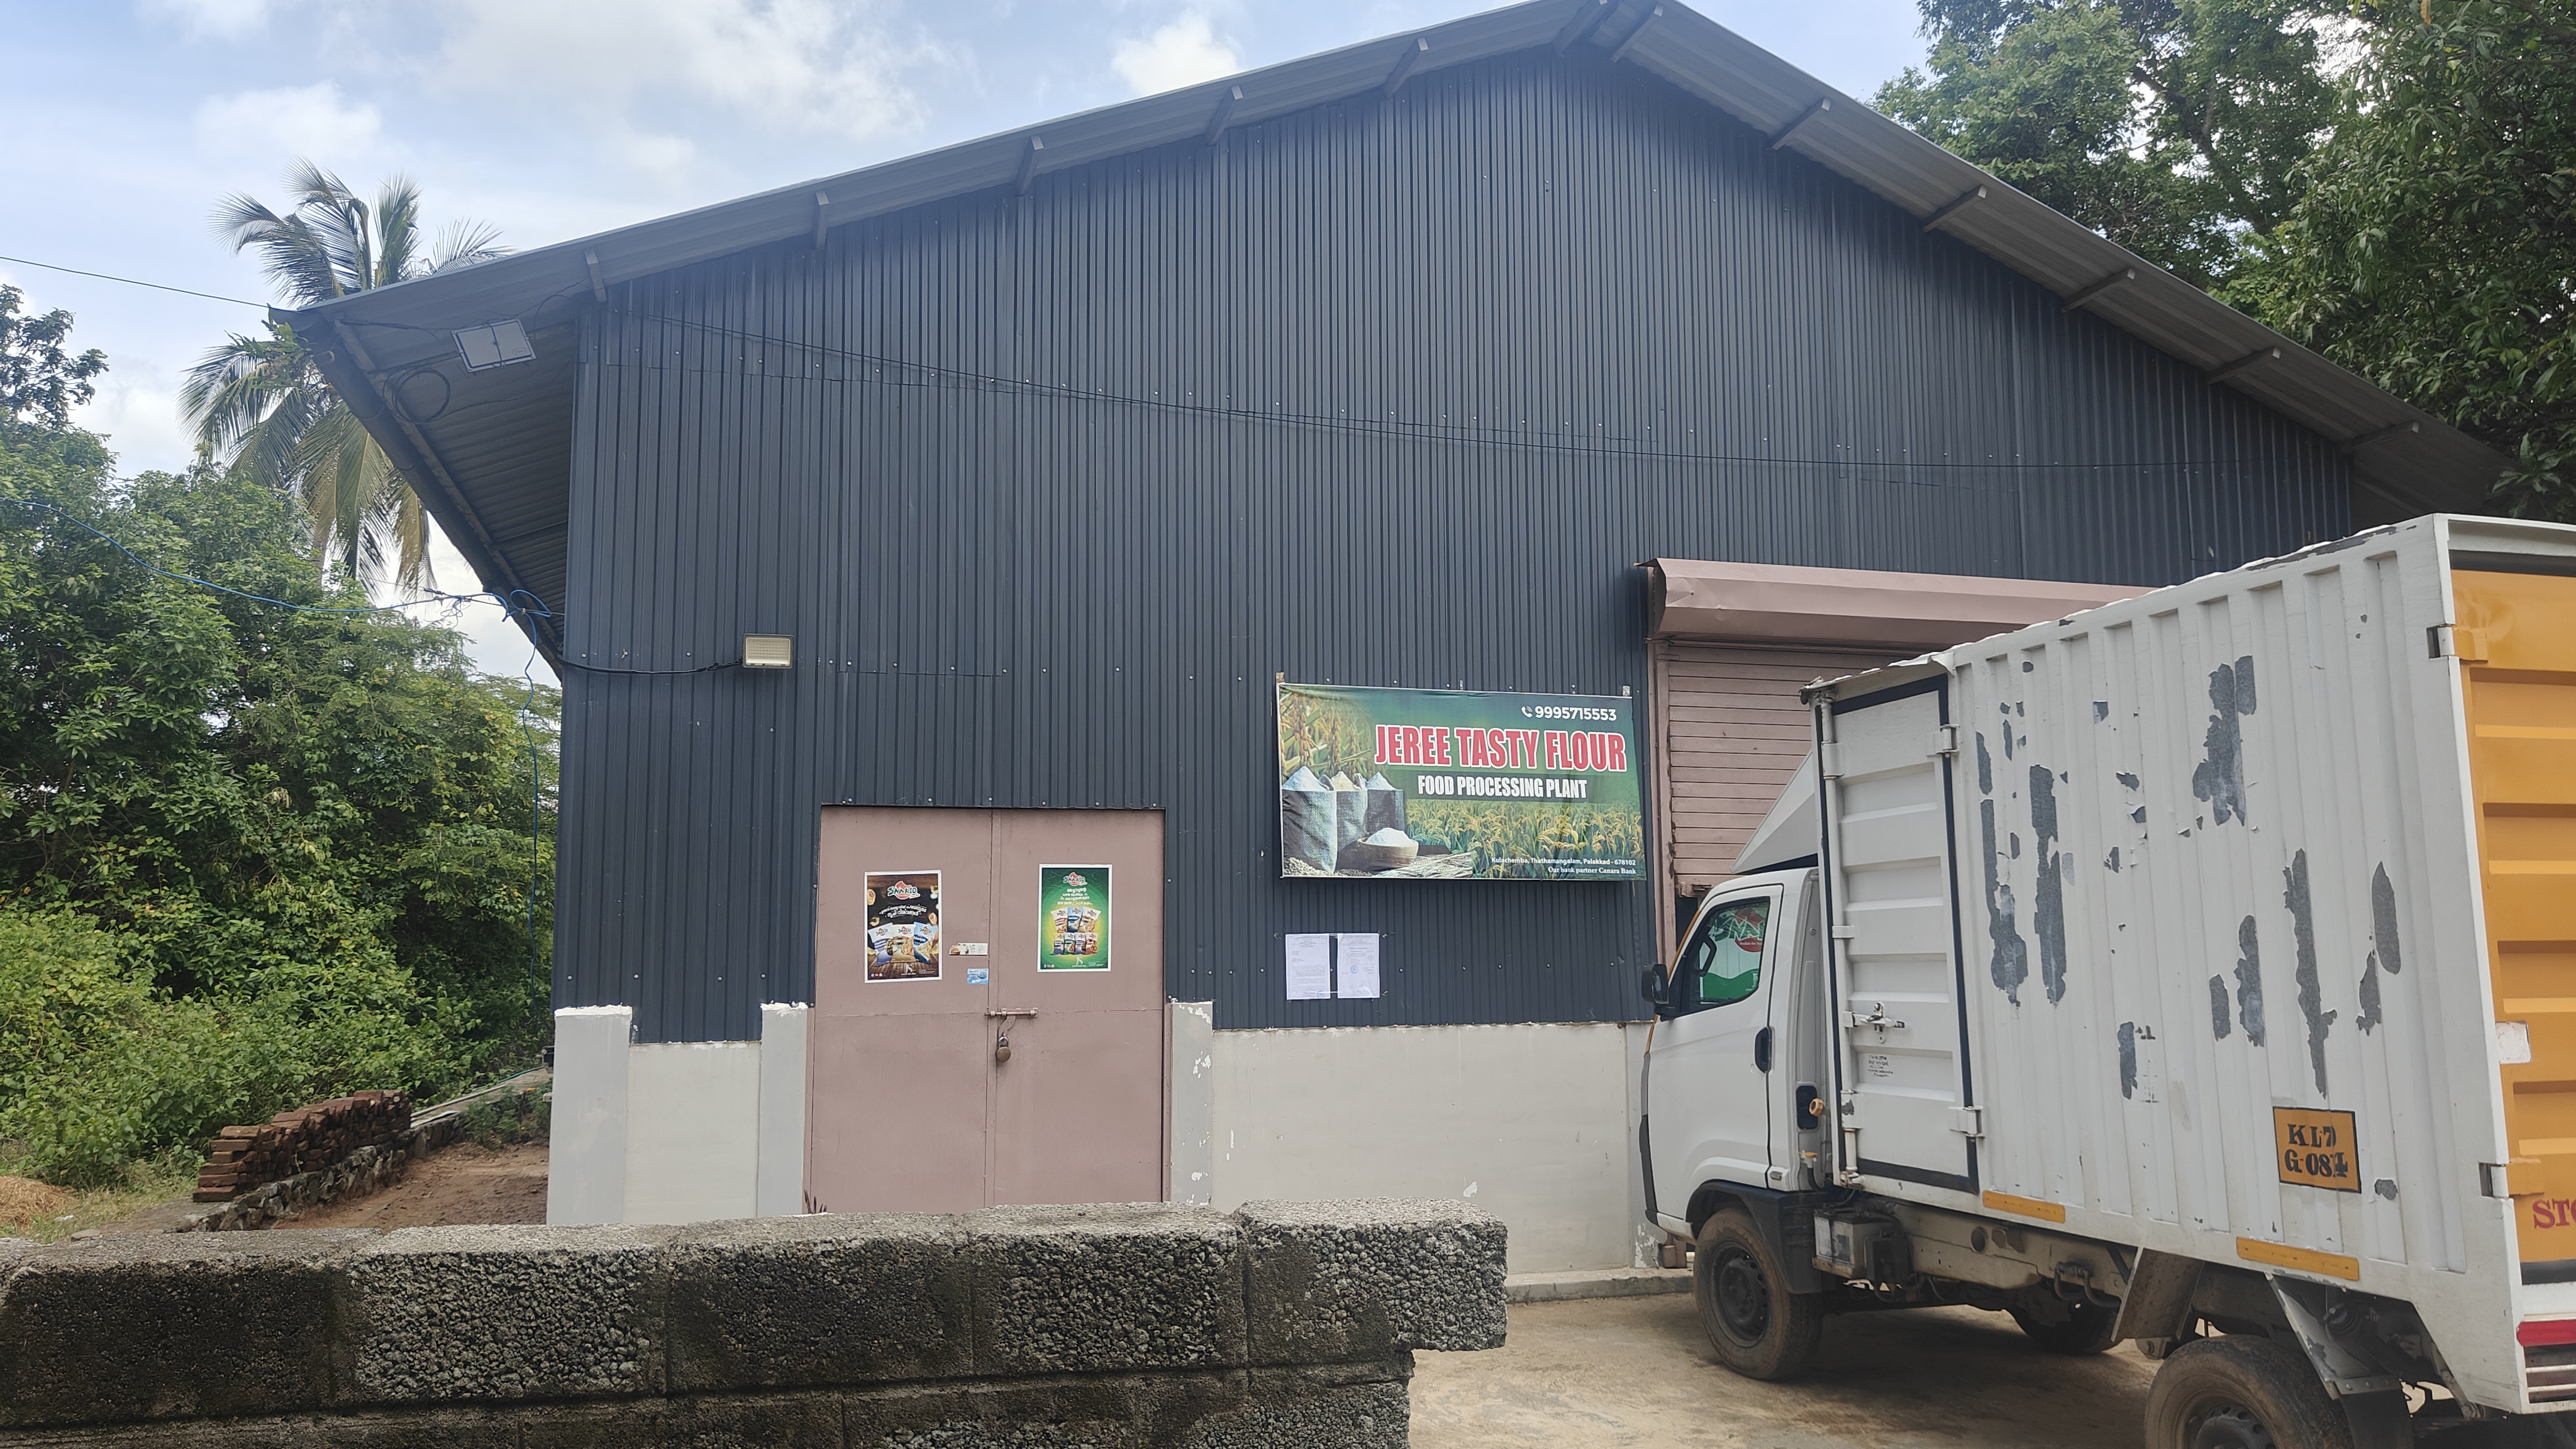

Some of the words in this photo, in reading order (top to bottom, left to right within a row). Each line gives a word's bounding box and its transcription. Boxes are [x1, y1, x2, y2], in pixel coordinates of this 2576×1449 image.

[1535, 706, 1617, 721] 9995715553
[1375, 724, 1452, 767] JEREE
[1454, 727, 1540, 769] TASTY
[1544, 730, 1628, 772] FLOUR
[1418, 775, 1455, 795] FOOD
[1457, 776, 1544, 797] PROCESSING
[1546, 779, 1587, 799] PLANT
[1491, 857, 1530, 865] Kulachemba,
[1531, 857, 1582, 865] Thathamangalam,
